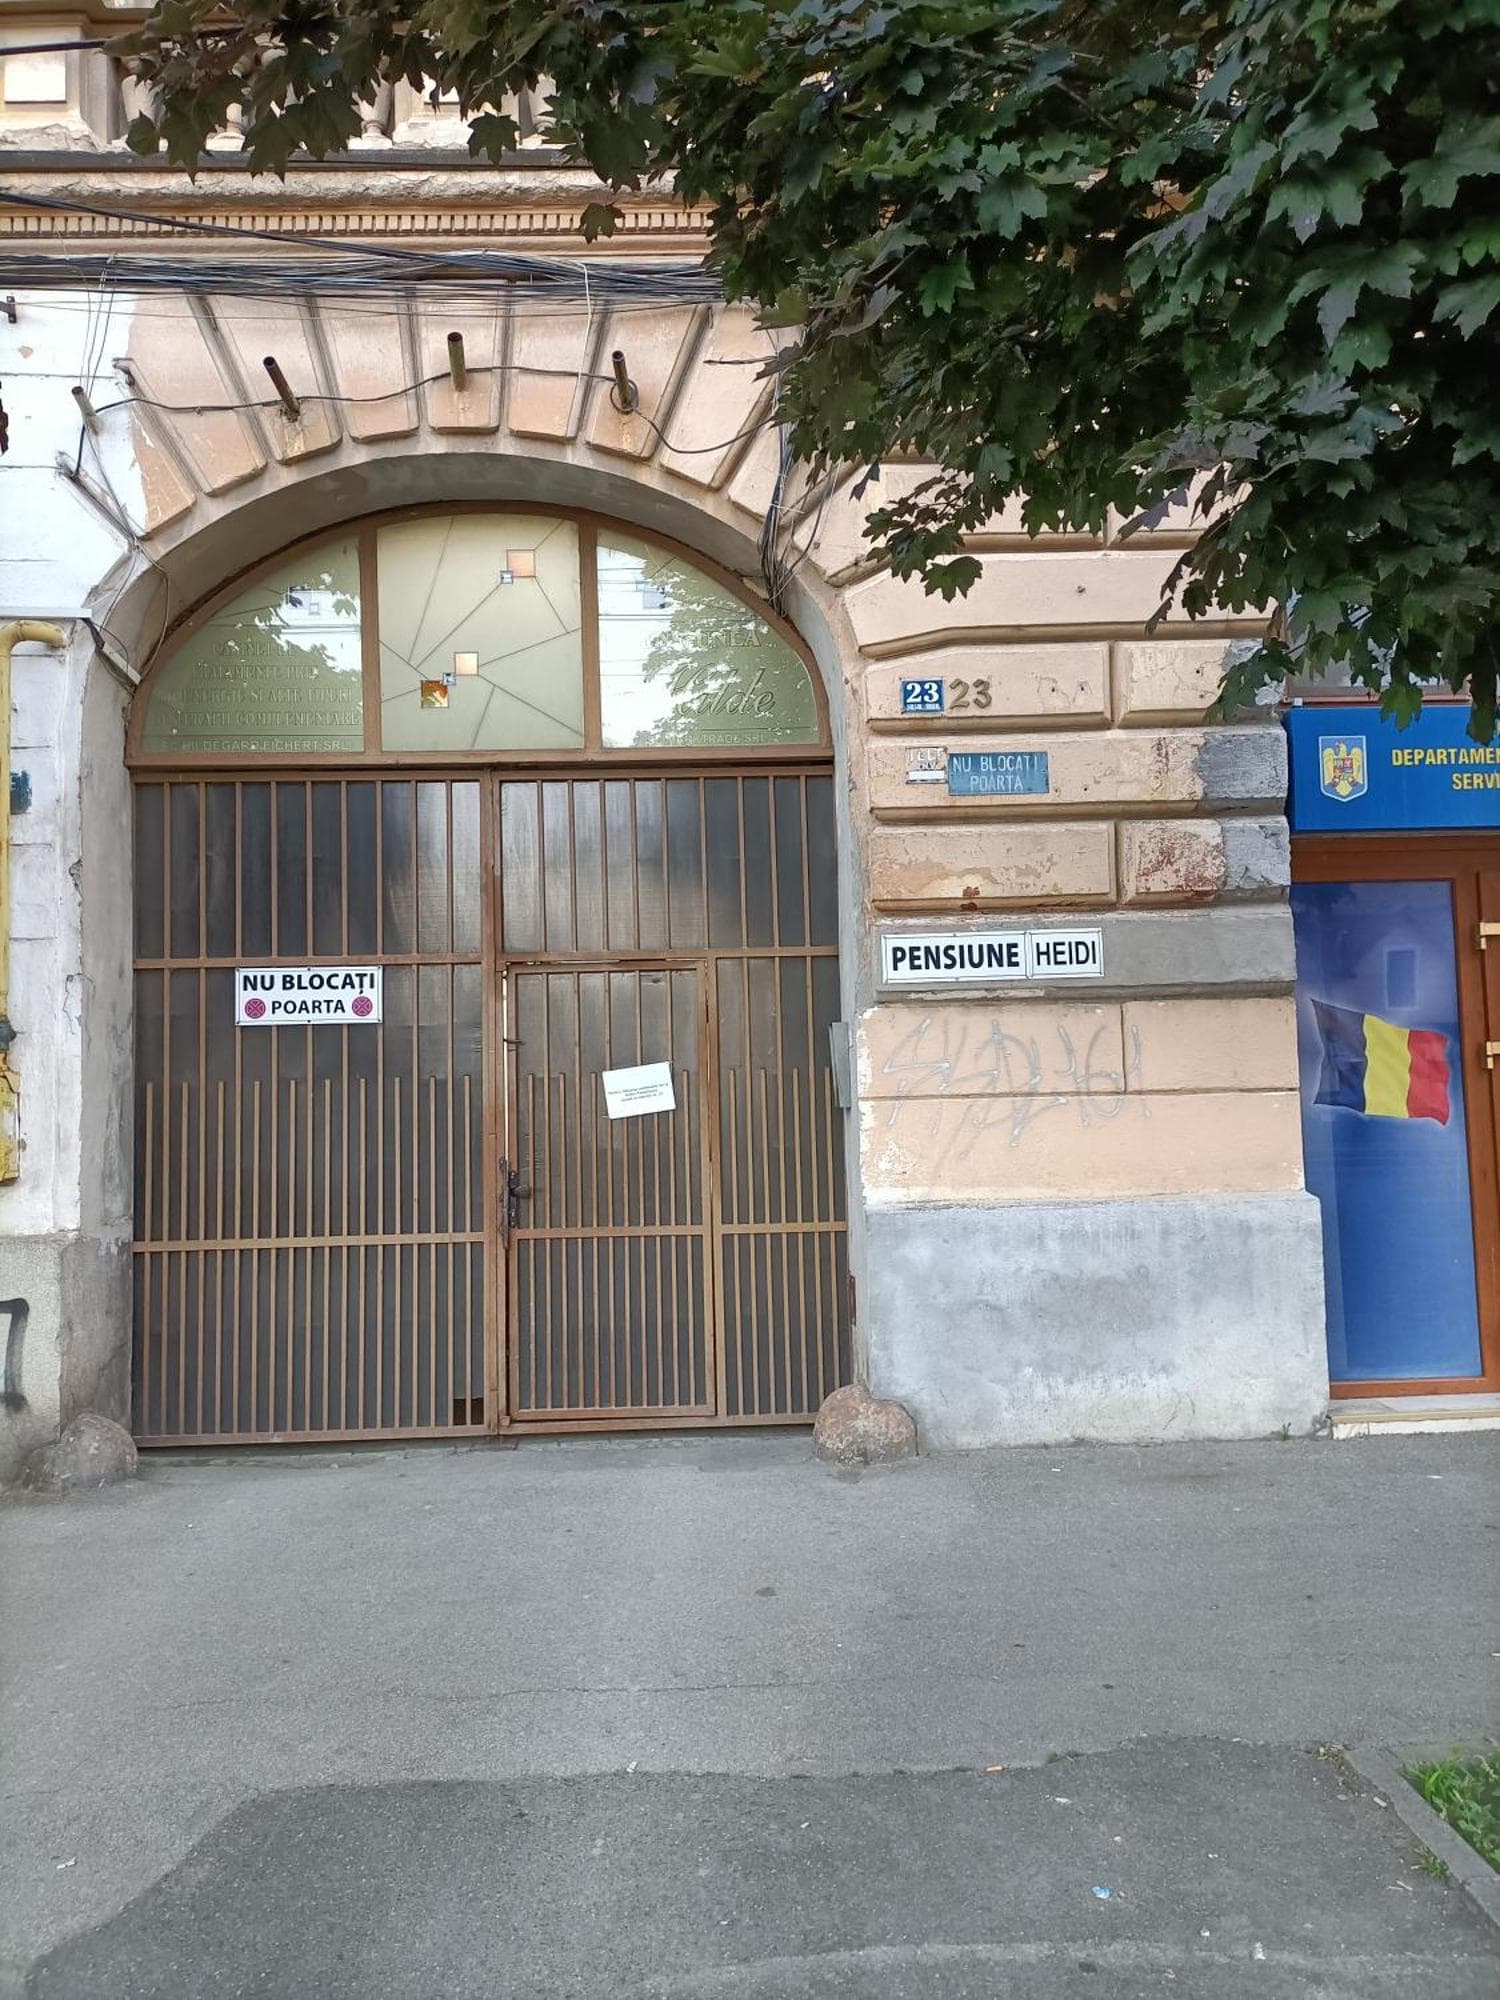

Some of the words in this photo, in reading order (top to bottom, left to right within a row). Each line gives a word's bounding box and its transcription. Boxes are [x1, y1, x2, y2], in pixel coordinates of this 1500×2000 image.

[906, 682, 940, 703] 23
[949, 678, 993, 710] 23
[952, 756, 972, 773] NU
[980, 755, 1038, 772] BLOCATI
[970, 775, 1024, 793] POARTA
[892, 942, 1020, 971] PENSIUNE
[1035, 941, 1097, 966] HEIDI
[243, 974, 275, 991] NU
[271, 999, 346, 1015] POARTA
